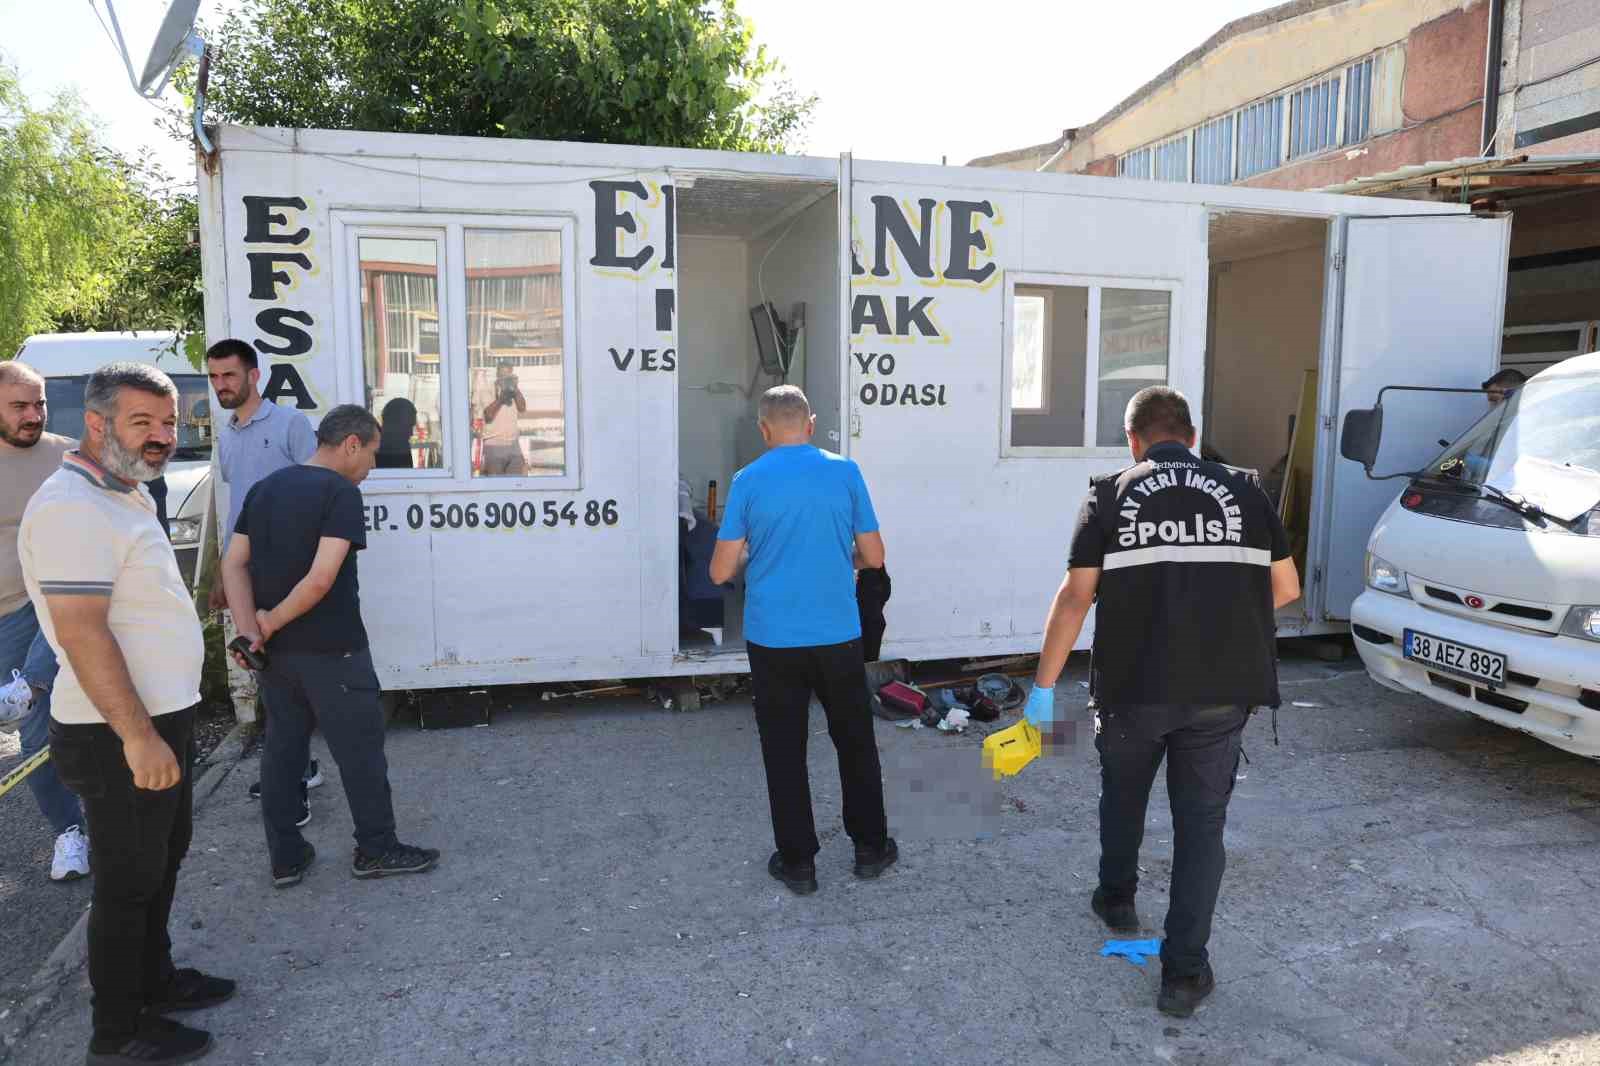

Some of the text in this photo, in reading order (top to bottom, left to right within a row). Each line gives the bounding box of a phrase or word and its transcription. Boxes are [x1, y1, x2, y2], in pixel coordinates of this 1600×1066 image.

[860, 383, 947, 406] ODASI
[406, 503, 424, 530] 0
[430, 503, 479, 529] 506
[484, 501, 536, 529] 900
[543, 500, 578, 527] 54
[584, 499, 619, 527] 86
[1118, 496, 1142, 547] OLAY
[1413, 636, 1430, 658] 38
[1436, 643, 1465, 668] AEZ
[1470, 652, 1502, 680] 892
